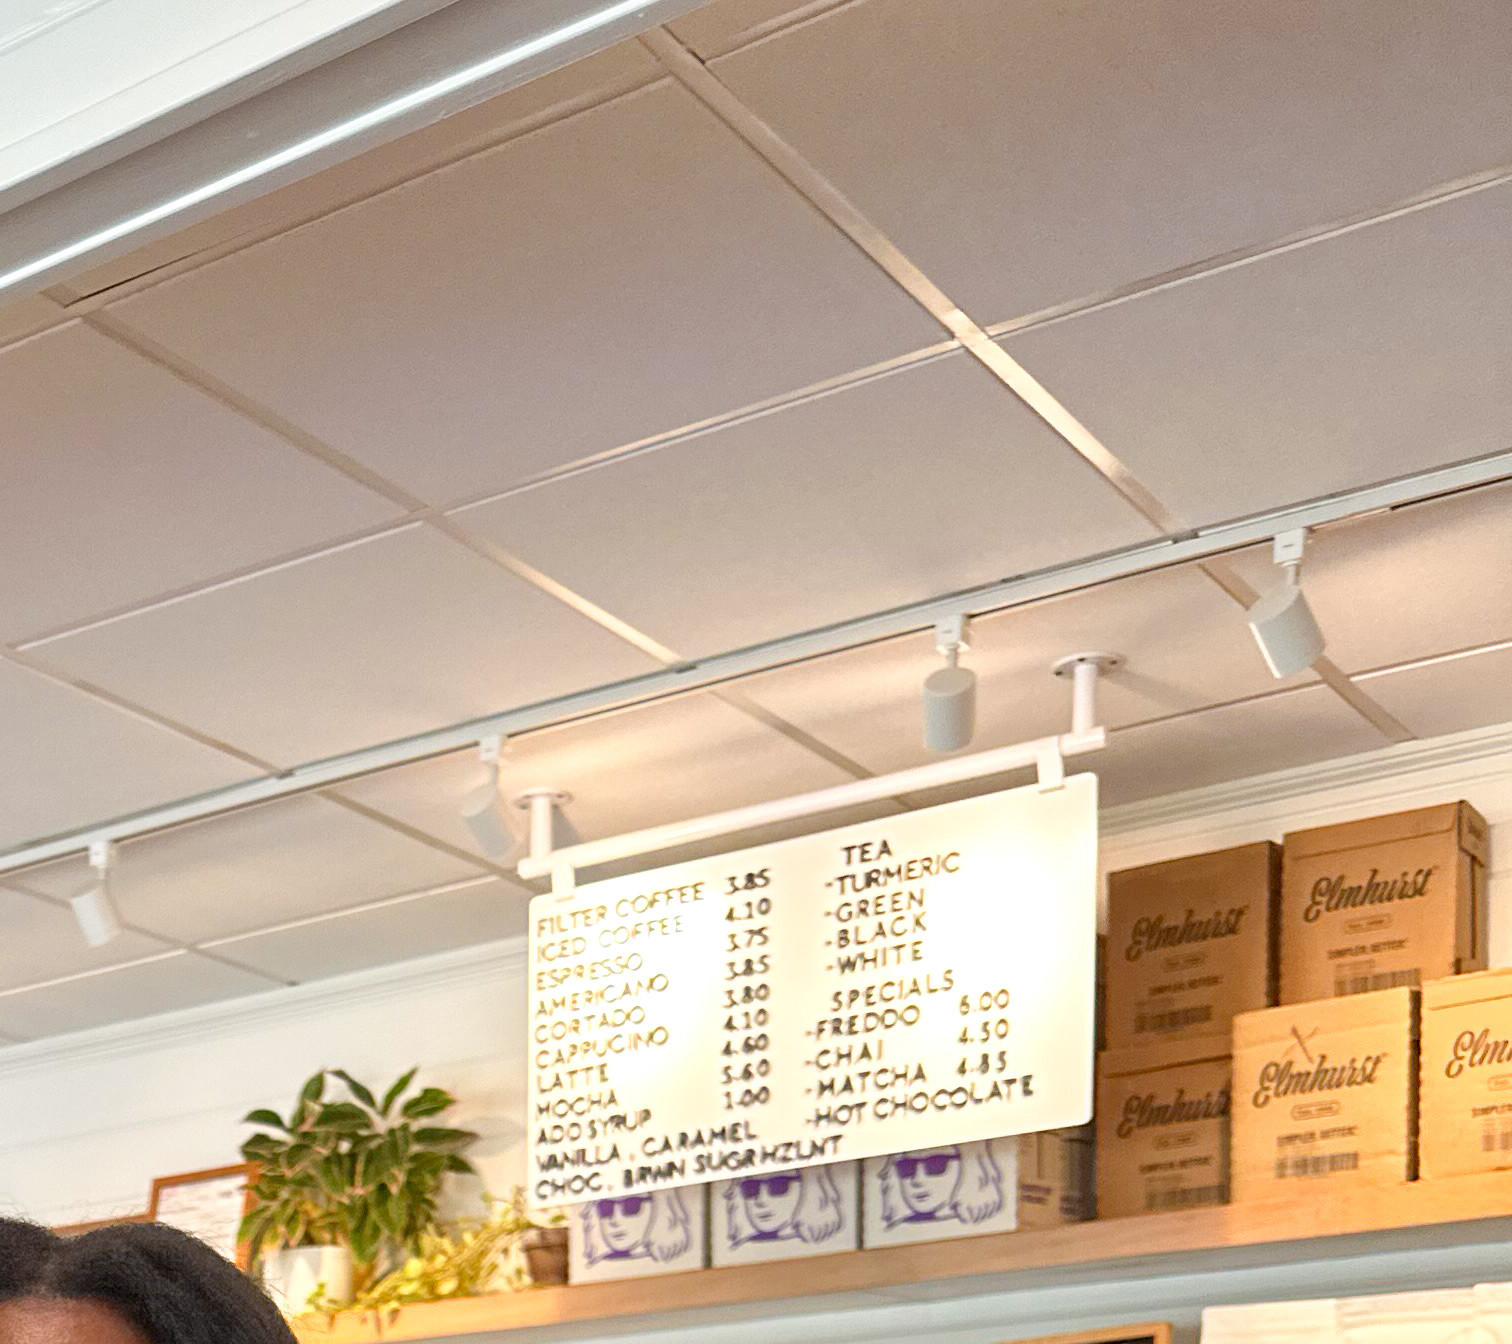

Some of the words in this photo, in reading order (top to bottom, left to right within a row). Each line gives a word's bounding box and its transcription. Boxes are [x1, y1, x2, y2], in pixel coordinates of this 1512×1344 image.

[841, 839, 893, 867] TEA
[537, 905, 608, 938] FILTER
[615, 881, 705, 918] COFFEE
[724, 868, 772, 896] 3.85
[1302, 866, 1435, 924] Elmhurst
[536, 936, 587, 964] ICED
[598, 914, 684, 948] COFFEE
[1124, 905, 1246, 963] Elmhurst
[536, 952, 643, 991] ESPRESSO
[830, 968, 955, 1012] SPECIALS
[534, 973, 670, 1019] AMERICANO
[535, 1005, 646, 1044] CORTADO
[535, 1025, 670, 1069] CAPPUCINO
[536, 1062, 609, 1094] LATTE
[873, 1074, 1035, 1120] CHOCOLATE
[1251, 1053, 1383, 1108] Elmhurst
[535, 1088, 619, 1121] MOCHA
[588, 1108, 652, 1140] SYRUP
[641, 1120, 759, 1157] CARAMEL
